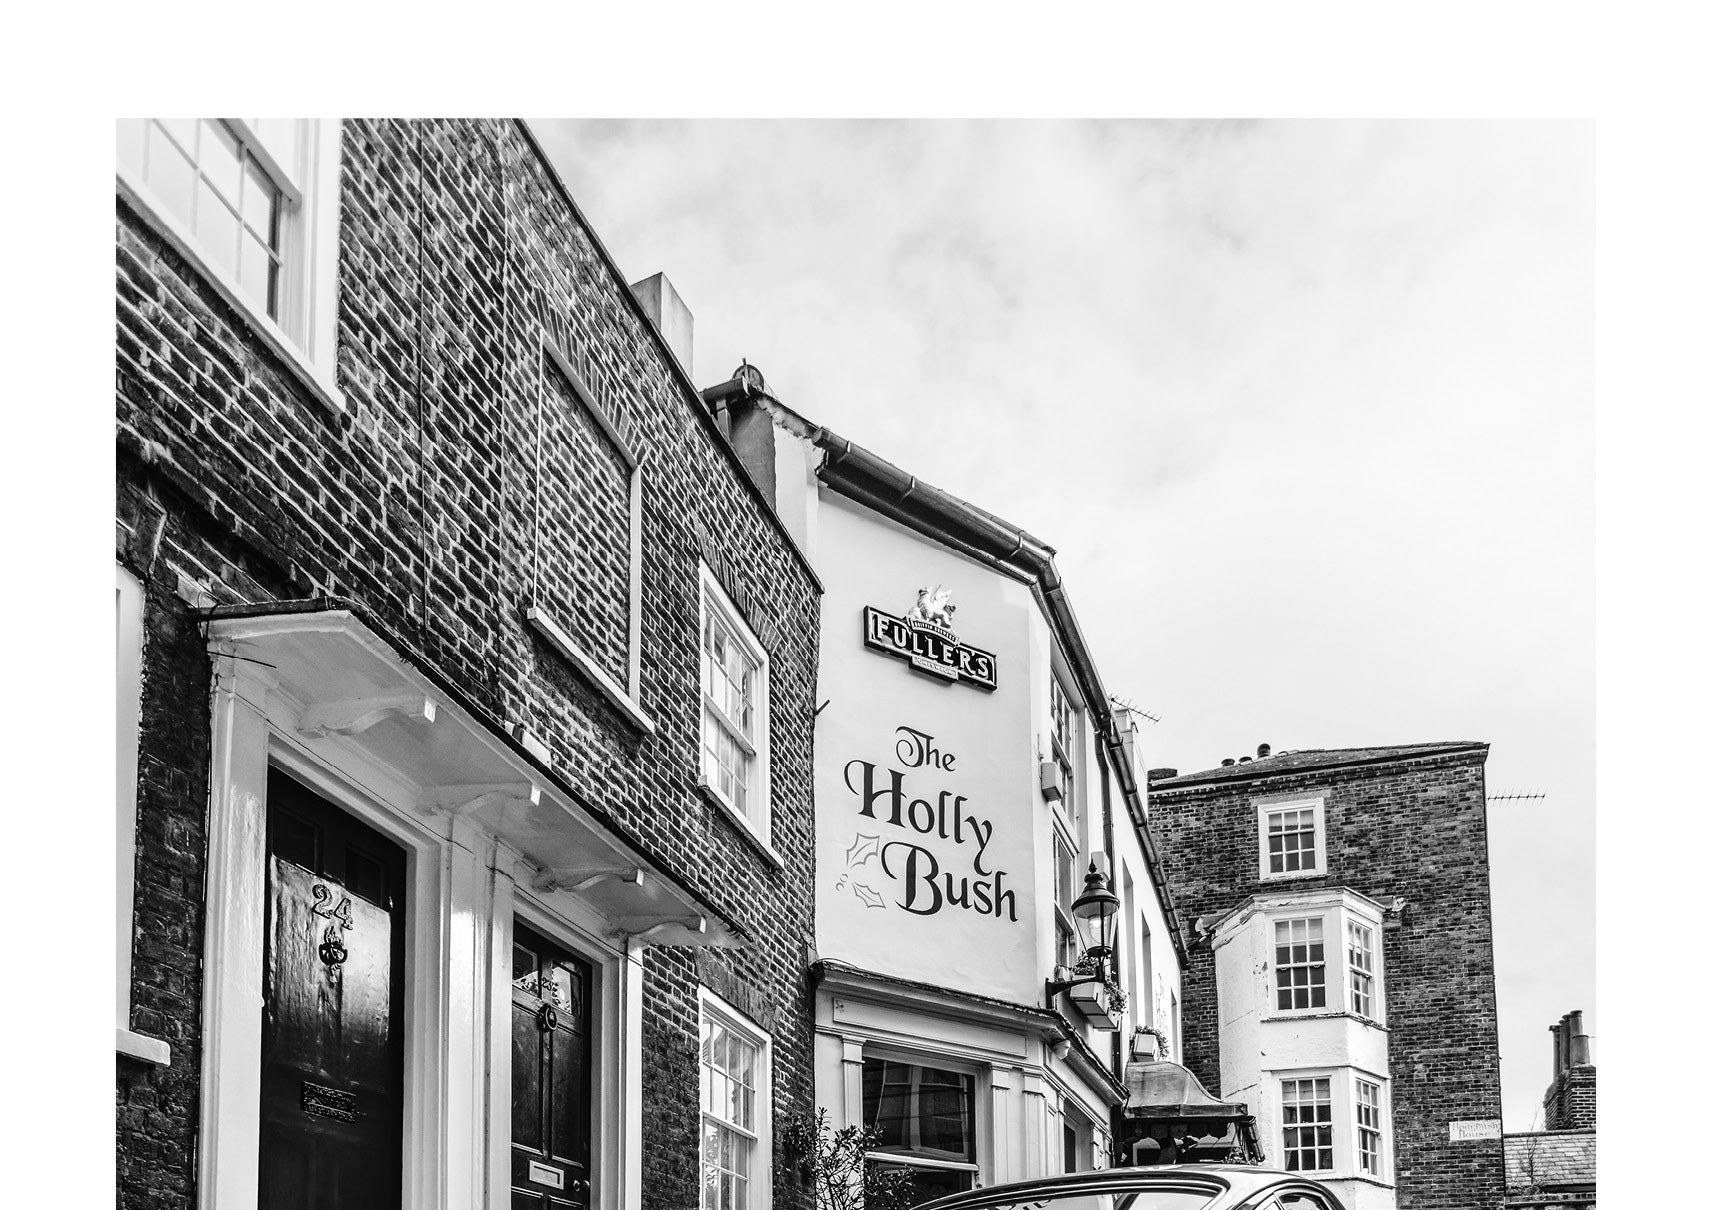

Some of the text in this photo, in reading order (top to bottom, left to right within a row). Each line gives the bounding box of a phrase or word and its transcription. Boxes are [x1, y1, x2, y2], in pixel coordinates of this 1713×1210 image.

[877, 614, 989, 679] FULLER'S
[896, 725, 955, 772] The
[844, 759, 992, 876] Holly
[312, 883, 354, 931] 24
[881, 841, 1018, 923] Bush
